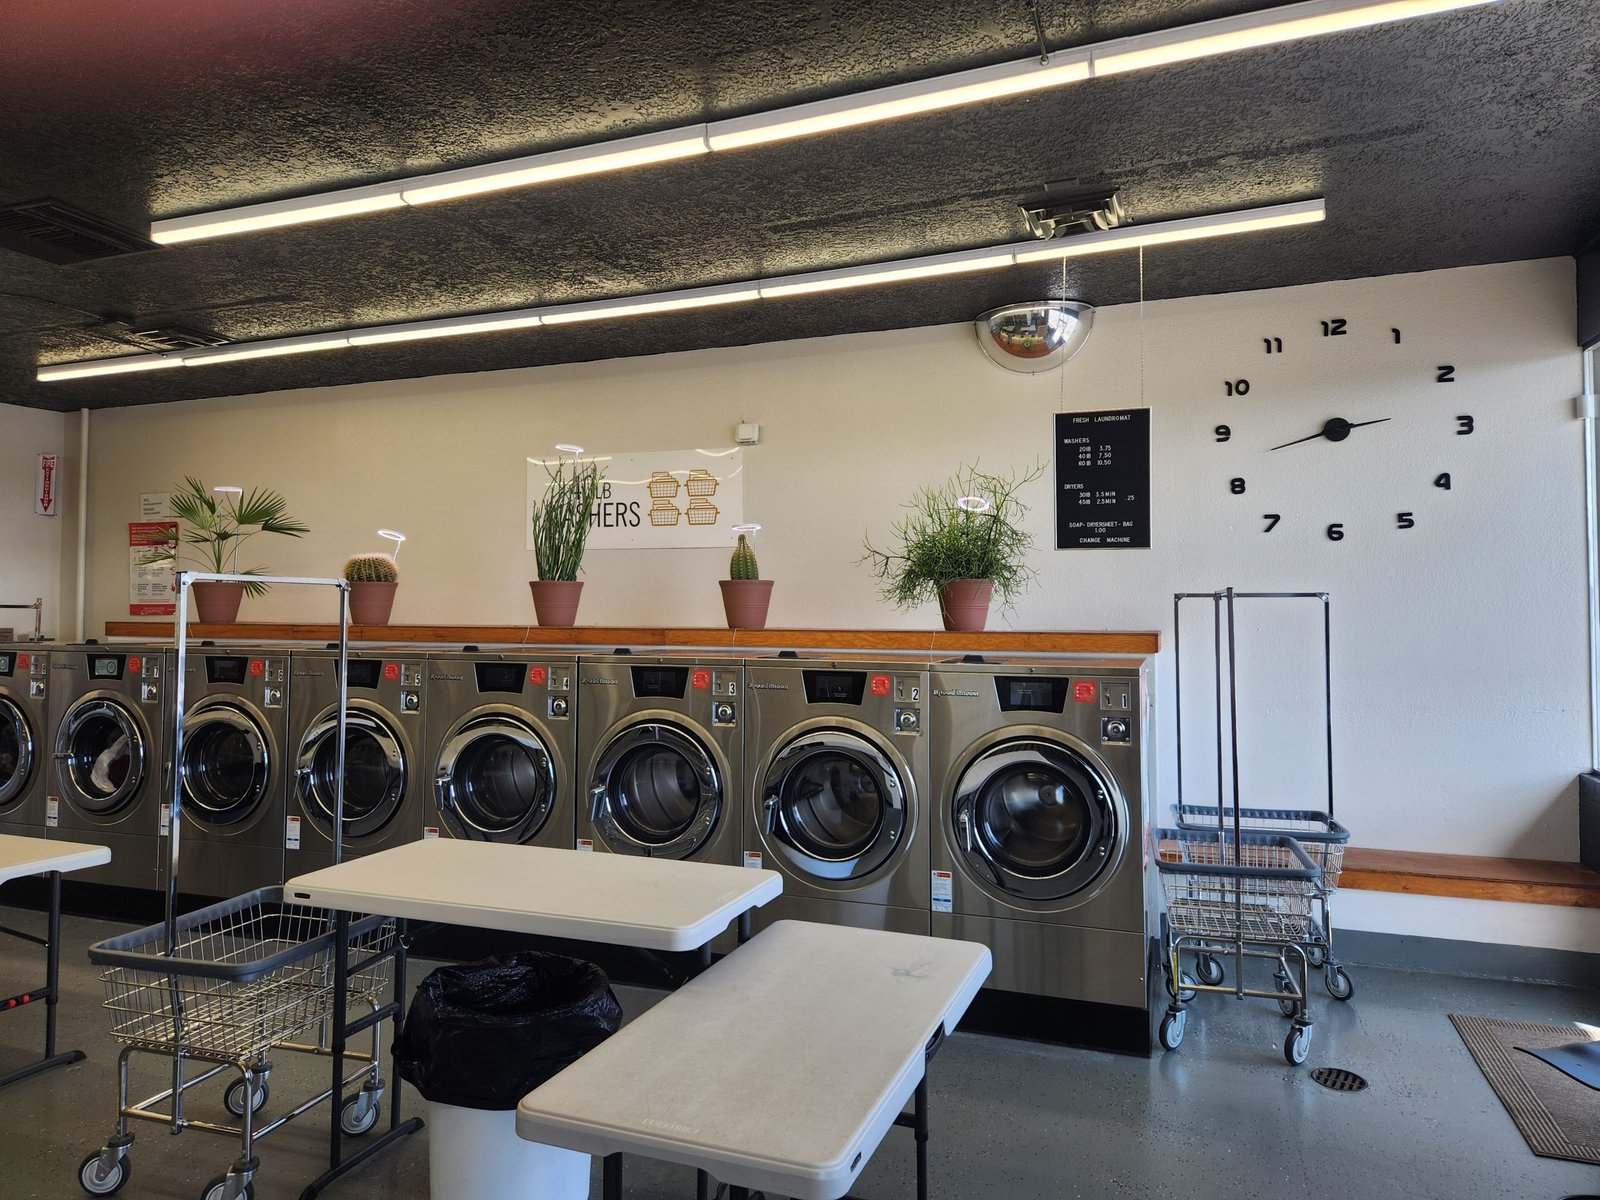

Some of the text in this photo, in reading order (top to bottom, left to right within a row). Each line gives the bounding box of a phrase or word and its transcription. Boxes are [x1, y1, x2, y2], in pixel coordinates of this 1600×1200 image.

[1321, 318, 1347, 337] 12
[1391, 328, 1401, 344] 1
[1263, 337, 1283, 354] 11
[1436, 365, 1455, 383] 2
[1224, 379, 1250, 397] 10
[1094, 414, 1131, 423] LAUNDROMAT
[1455, 415, 1474, 435] 3
[1215, 424, 1231, 443] 9
[1230, 477, 1246, 495] 8
[1433, 472, 1451, 490] 4
[1263, 513, 1281, 533] 7
[1396, 512, 1415, 529] 5
[1327, 523, 1345, 542] 6
[415, 674, 421, 685] 5
[563, 678, 569, 689] 4
[729, 682, 736, 695] 3
[912, 688, 919, 701] 2
